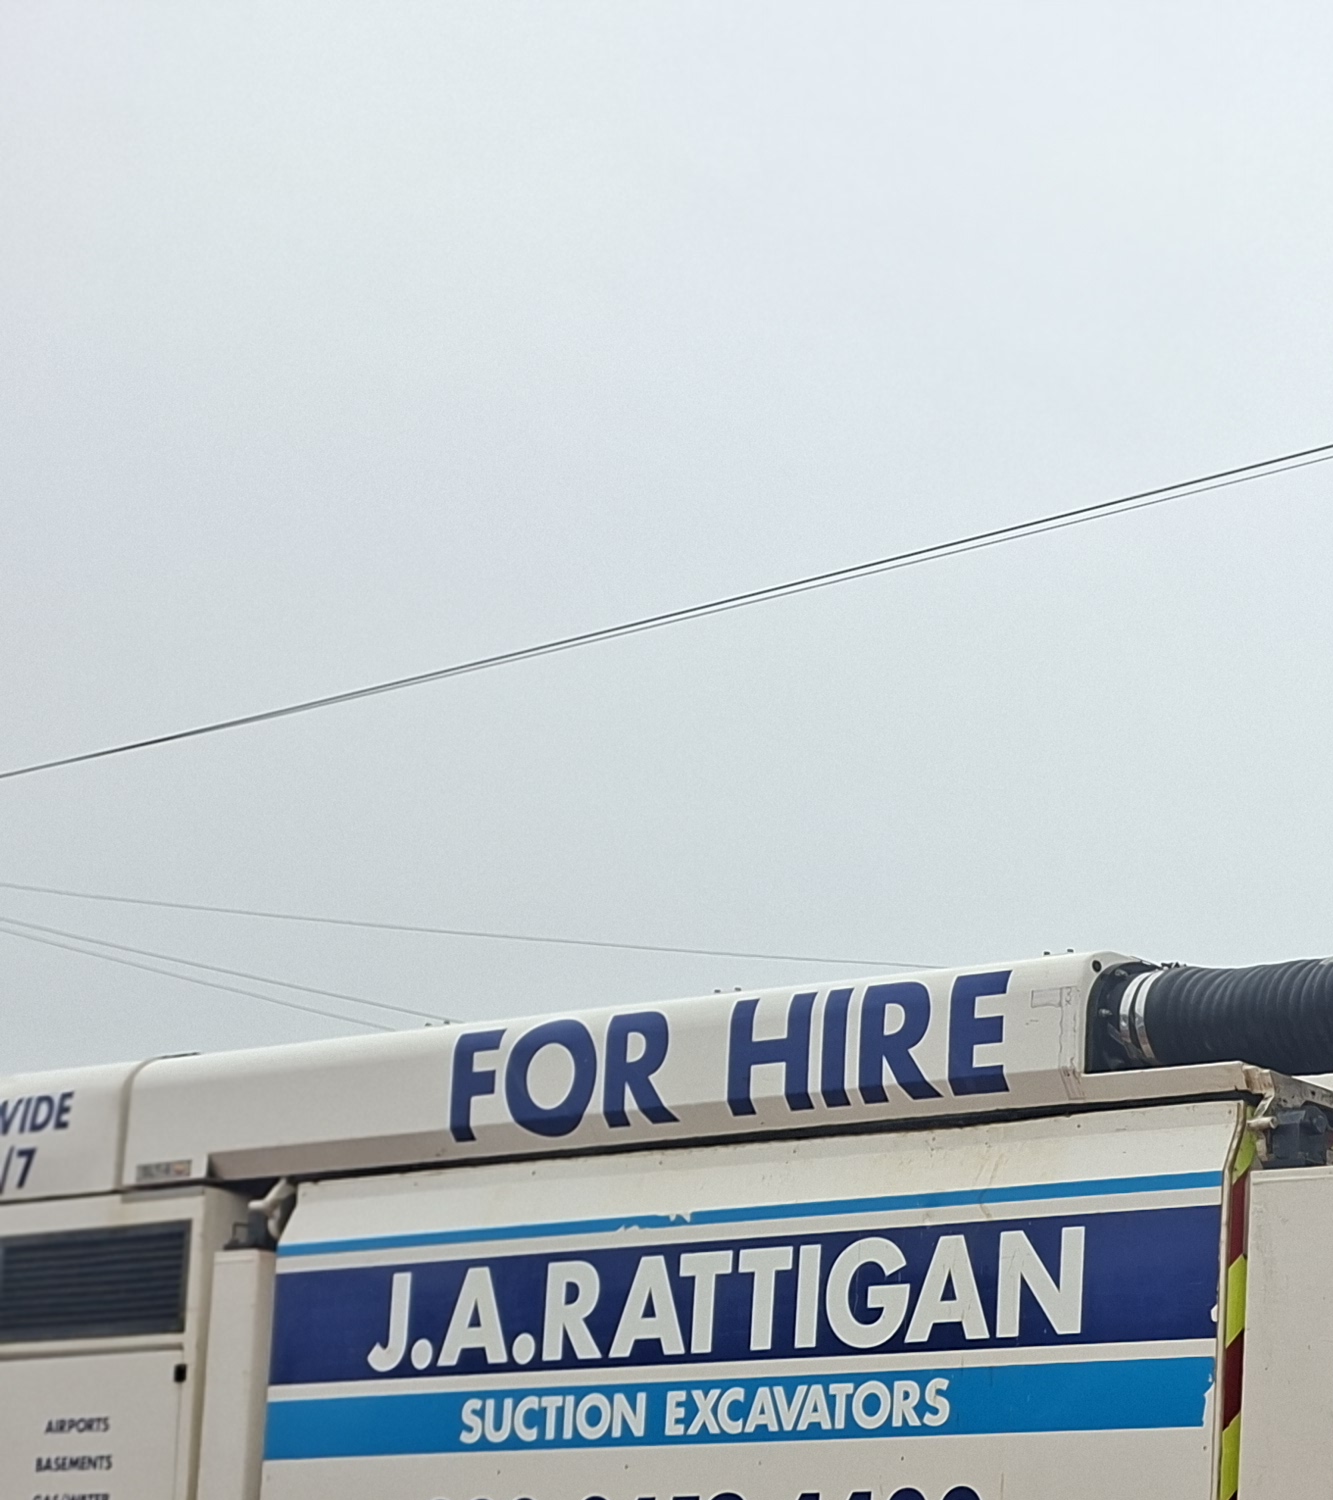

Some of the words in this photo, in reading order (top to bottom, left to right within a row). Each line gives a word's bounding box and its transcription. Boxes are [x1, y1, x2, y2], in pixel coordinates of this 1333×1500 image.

[449, 1010, 681, 1143] FOR
[727, 969, 1014, 1117] HIRE
[367, 1226, 1086, 1373] J.A.RATTIGAN
[45, 1416, 110, 1434] AIRPORTS
[459, 1391, 647, 1444] SUCTION
[663, 1377, 951, 1437] EXCAVATORS
[35, 1454, 113, 1472] BASEMENTS
